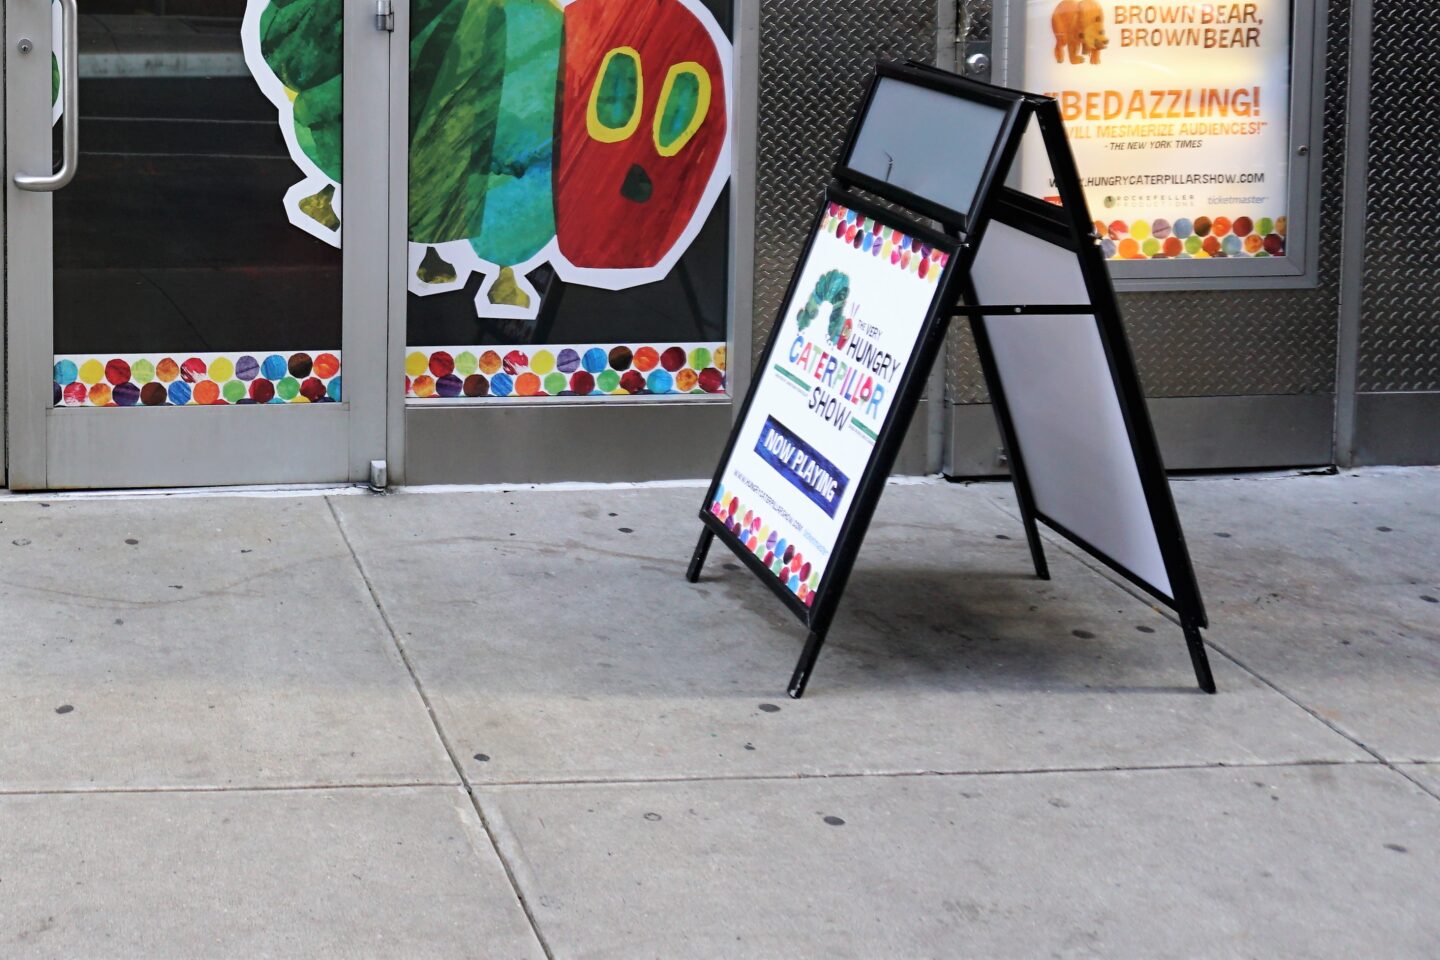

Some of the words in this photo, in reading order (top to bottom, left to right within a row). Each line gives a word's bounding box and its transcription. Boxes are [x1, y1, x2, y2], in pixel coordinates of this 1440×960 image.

[1114, 4, 1195, 25] BROWN
[1201, 3, 1263, 26] BEAR,
[1120, 28, 1200, 48] BROWN
[1203, 27, 1260, 49] BEAR
[1096, 123, 1176, 139] MESMERIZE
[1127, 142, 1147, 150] NEW
[1150, 141, 1172, 150] YORK
[1175, 140, 1202, 149] TIMES
[1049, 173, 1264, 187] W.HUNGRYCATERPILLARSHOW.COM
[866, 326, 883, 340] VERY
[846, 333, 901, 383] HUNGRY
[808, 386, 851, 431] SHOW
[763, 428, 796, 464] NOW
[790, 449, 838, 503] PLAYING
